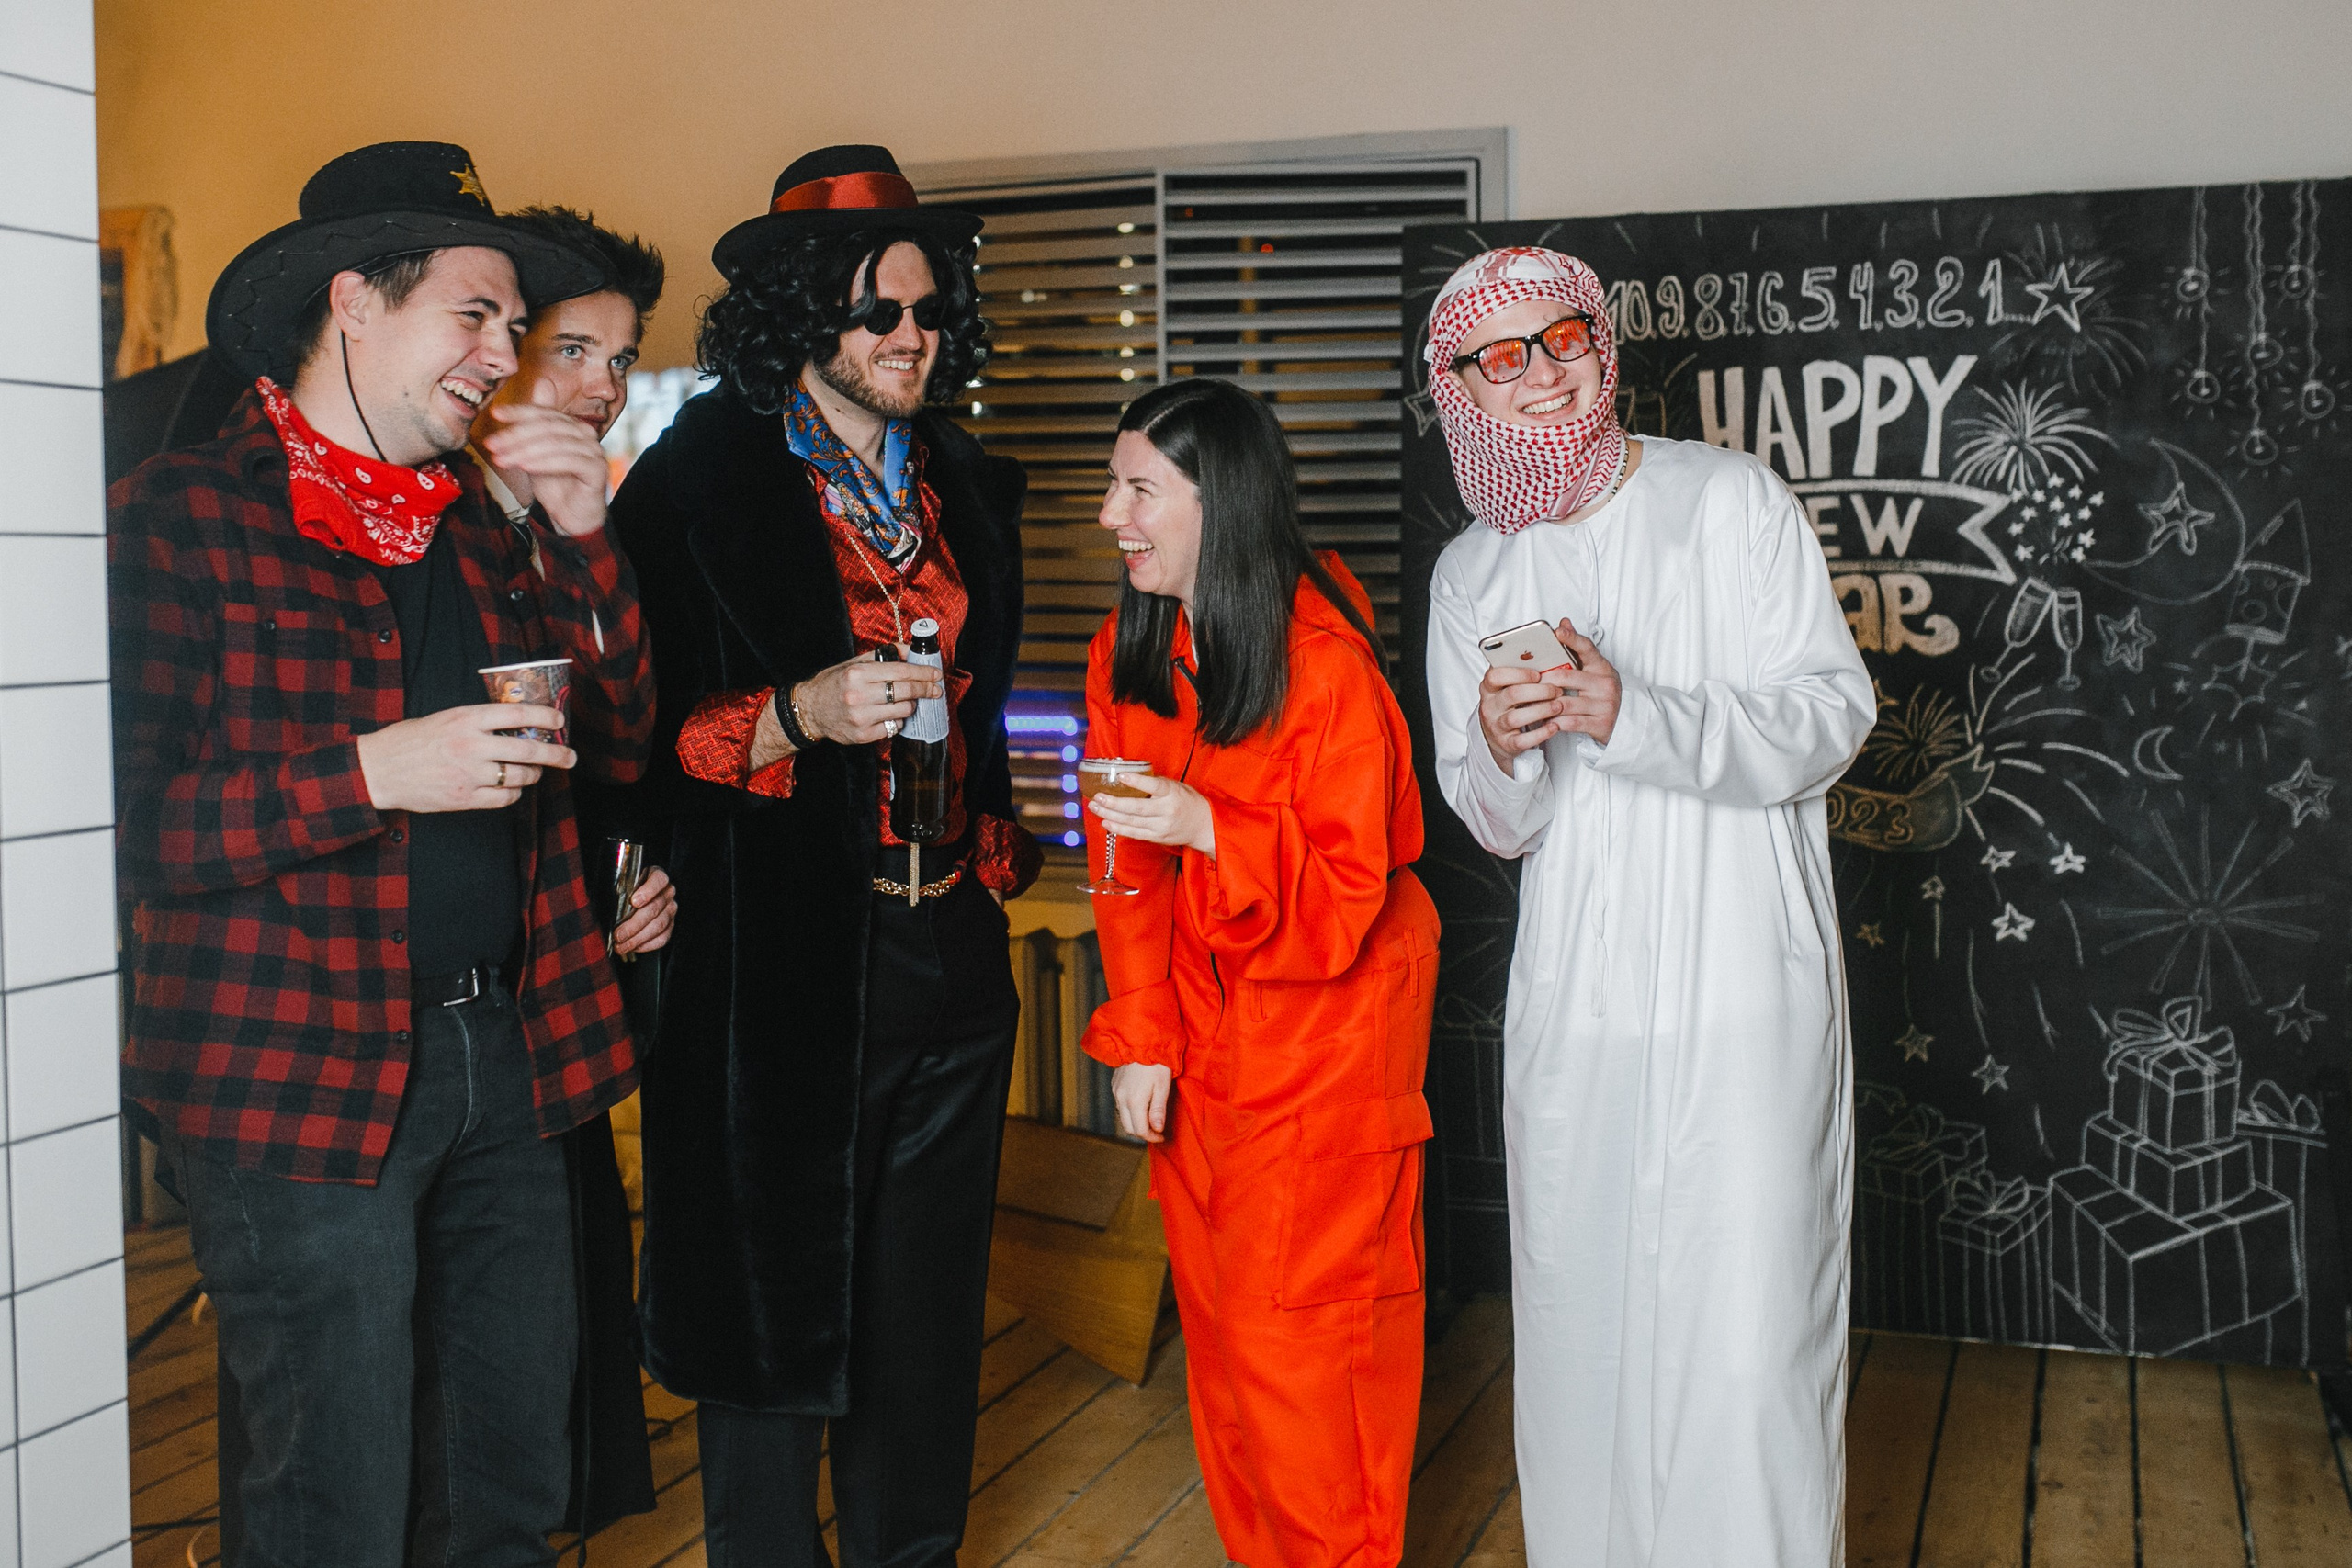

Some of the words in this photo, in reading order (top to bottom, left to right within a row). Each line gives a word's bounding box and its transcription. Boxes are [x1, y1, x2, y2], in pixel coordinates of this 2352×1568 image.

[1698, 355, 1978, 479] HAPPY
[1805, 493, 1924, 558] EW
[1832, 573, 1960, 656] AR
[1826, 790, 1914, 845] 023
